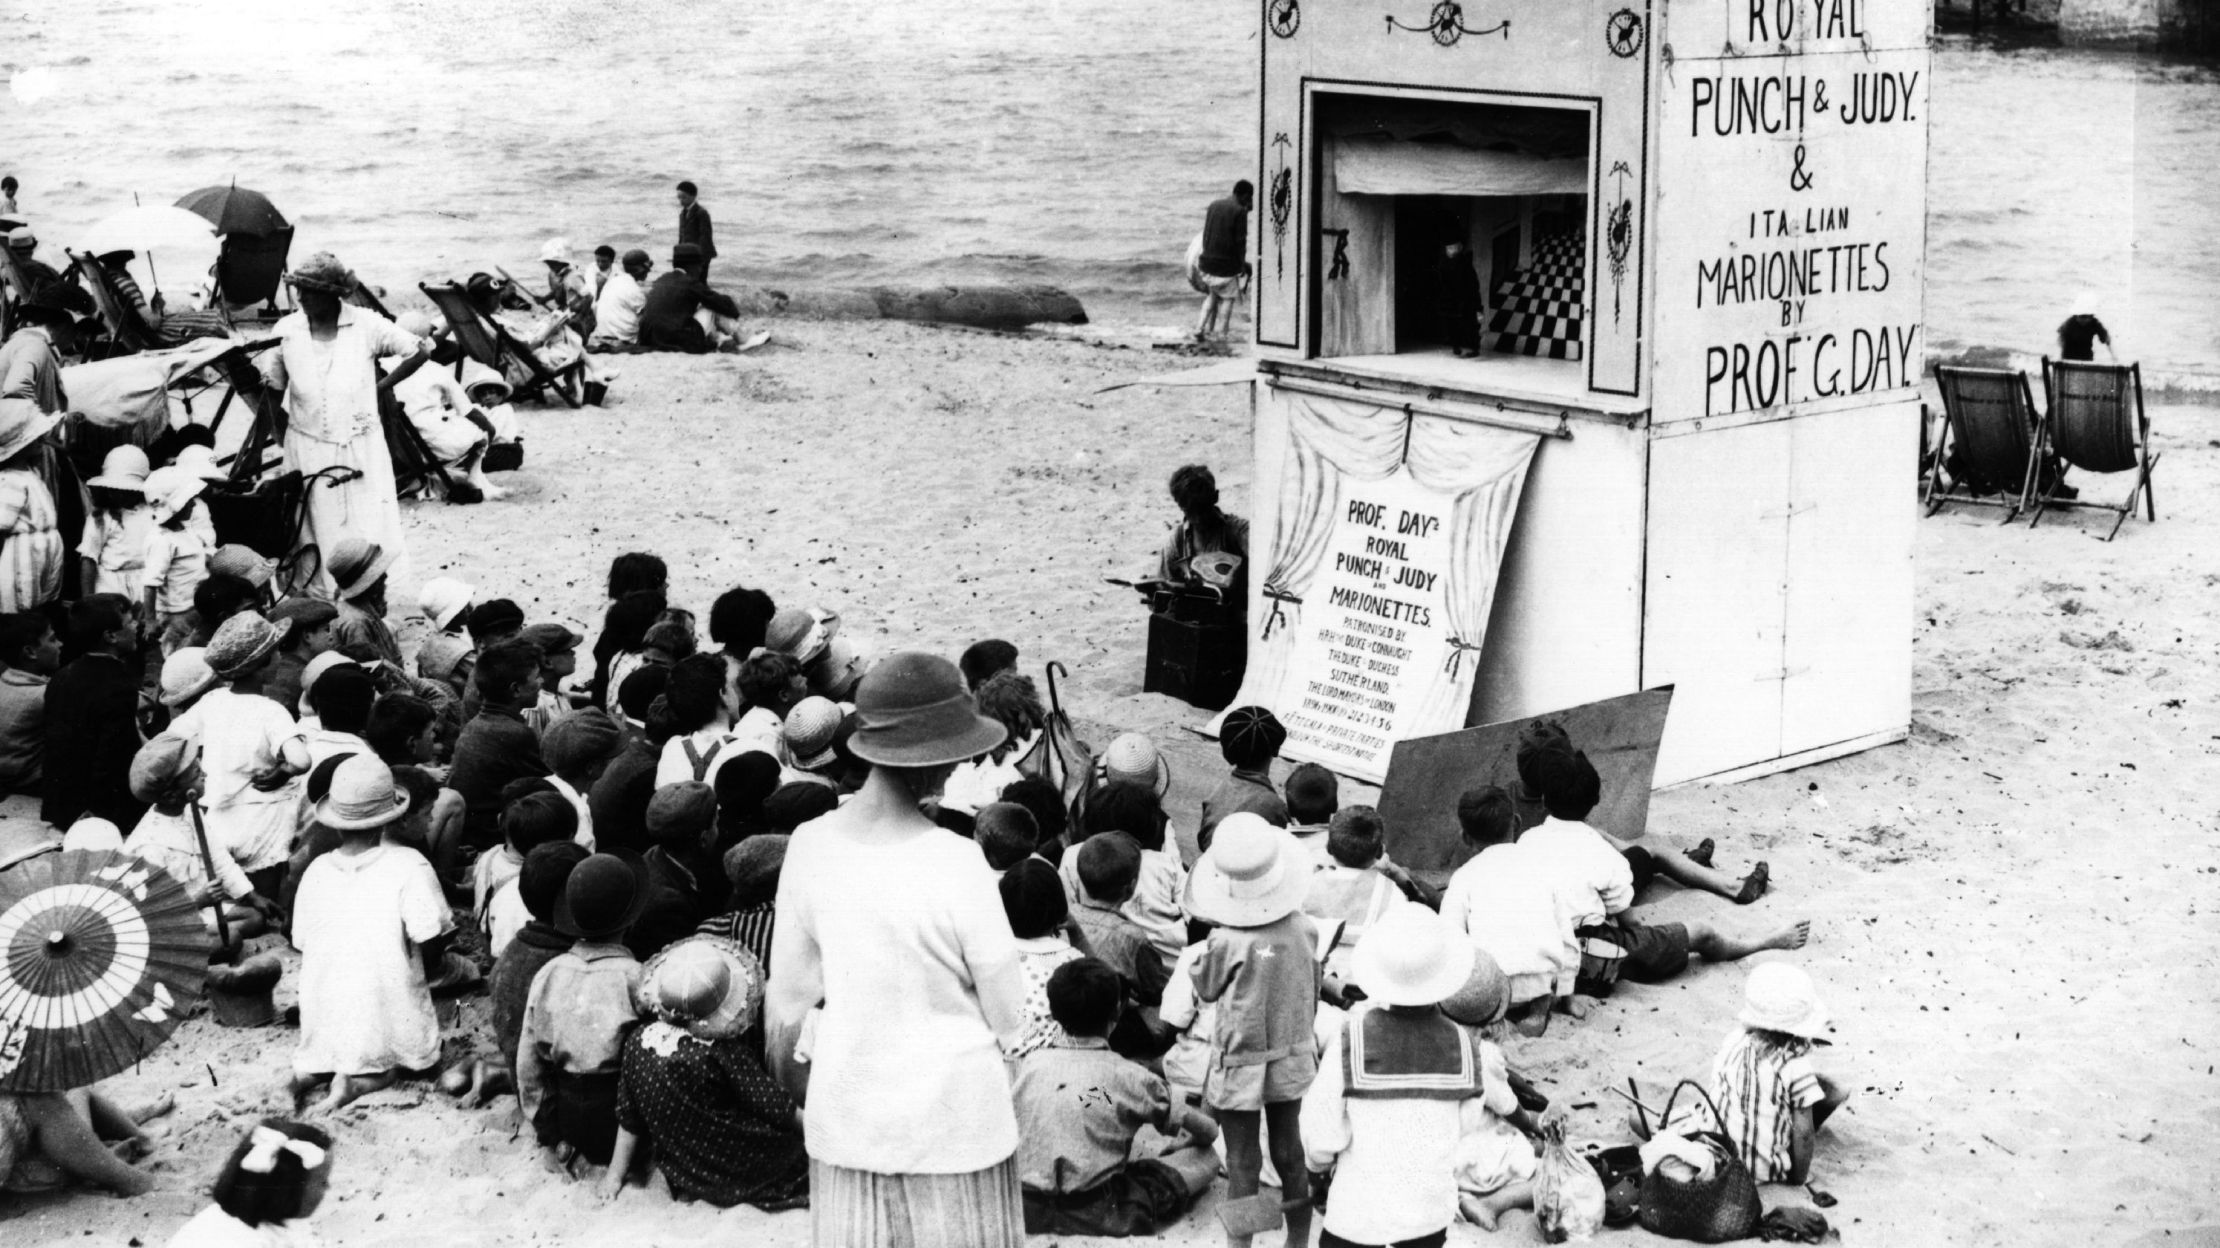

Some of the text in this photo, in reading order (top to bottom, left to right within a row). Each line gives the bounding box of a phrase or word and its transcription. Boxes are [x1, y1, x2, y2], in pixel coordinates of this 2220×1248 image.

[1691, 71, 1919, 137] PUNCH & JUDY.
[1790, 144, 1814, 191] &
[1750, 207, 1849, 238] ITALIAN
[1697, 242, 1890, 309] MARIONETTES
[1781, 300, 1806, 327] BY
[1347, 500, 1387, 530] PROF.
[1366, 535, 1409, 561] ROYAL
[1336, 552, 1382, 580] PUNCH
[1393, 566, 1438, 592] JUDY
[1328, 586, 1432, 628] MARIONETTES.
[1343, 616, 1407, 642] PATRONISED BY
[1328, 649, 1342, 662] THE
[1341, 652, 1362, 667] DUKE
[1367, 659, 1400, 676] DUCHESS
[1345, 634, 1367, 650] DUKE
[1371, 641, 1412, 661] CONNAUGHT
[1308, 680, 1322, 695] THE
[1369, 697, 1397, 714] LONDON
